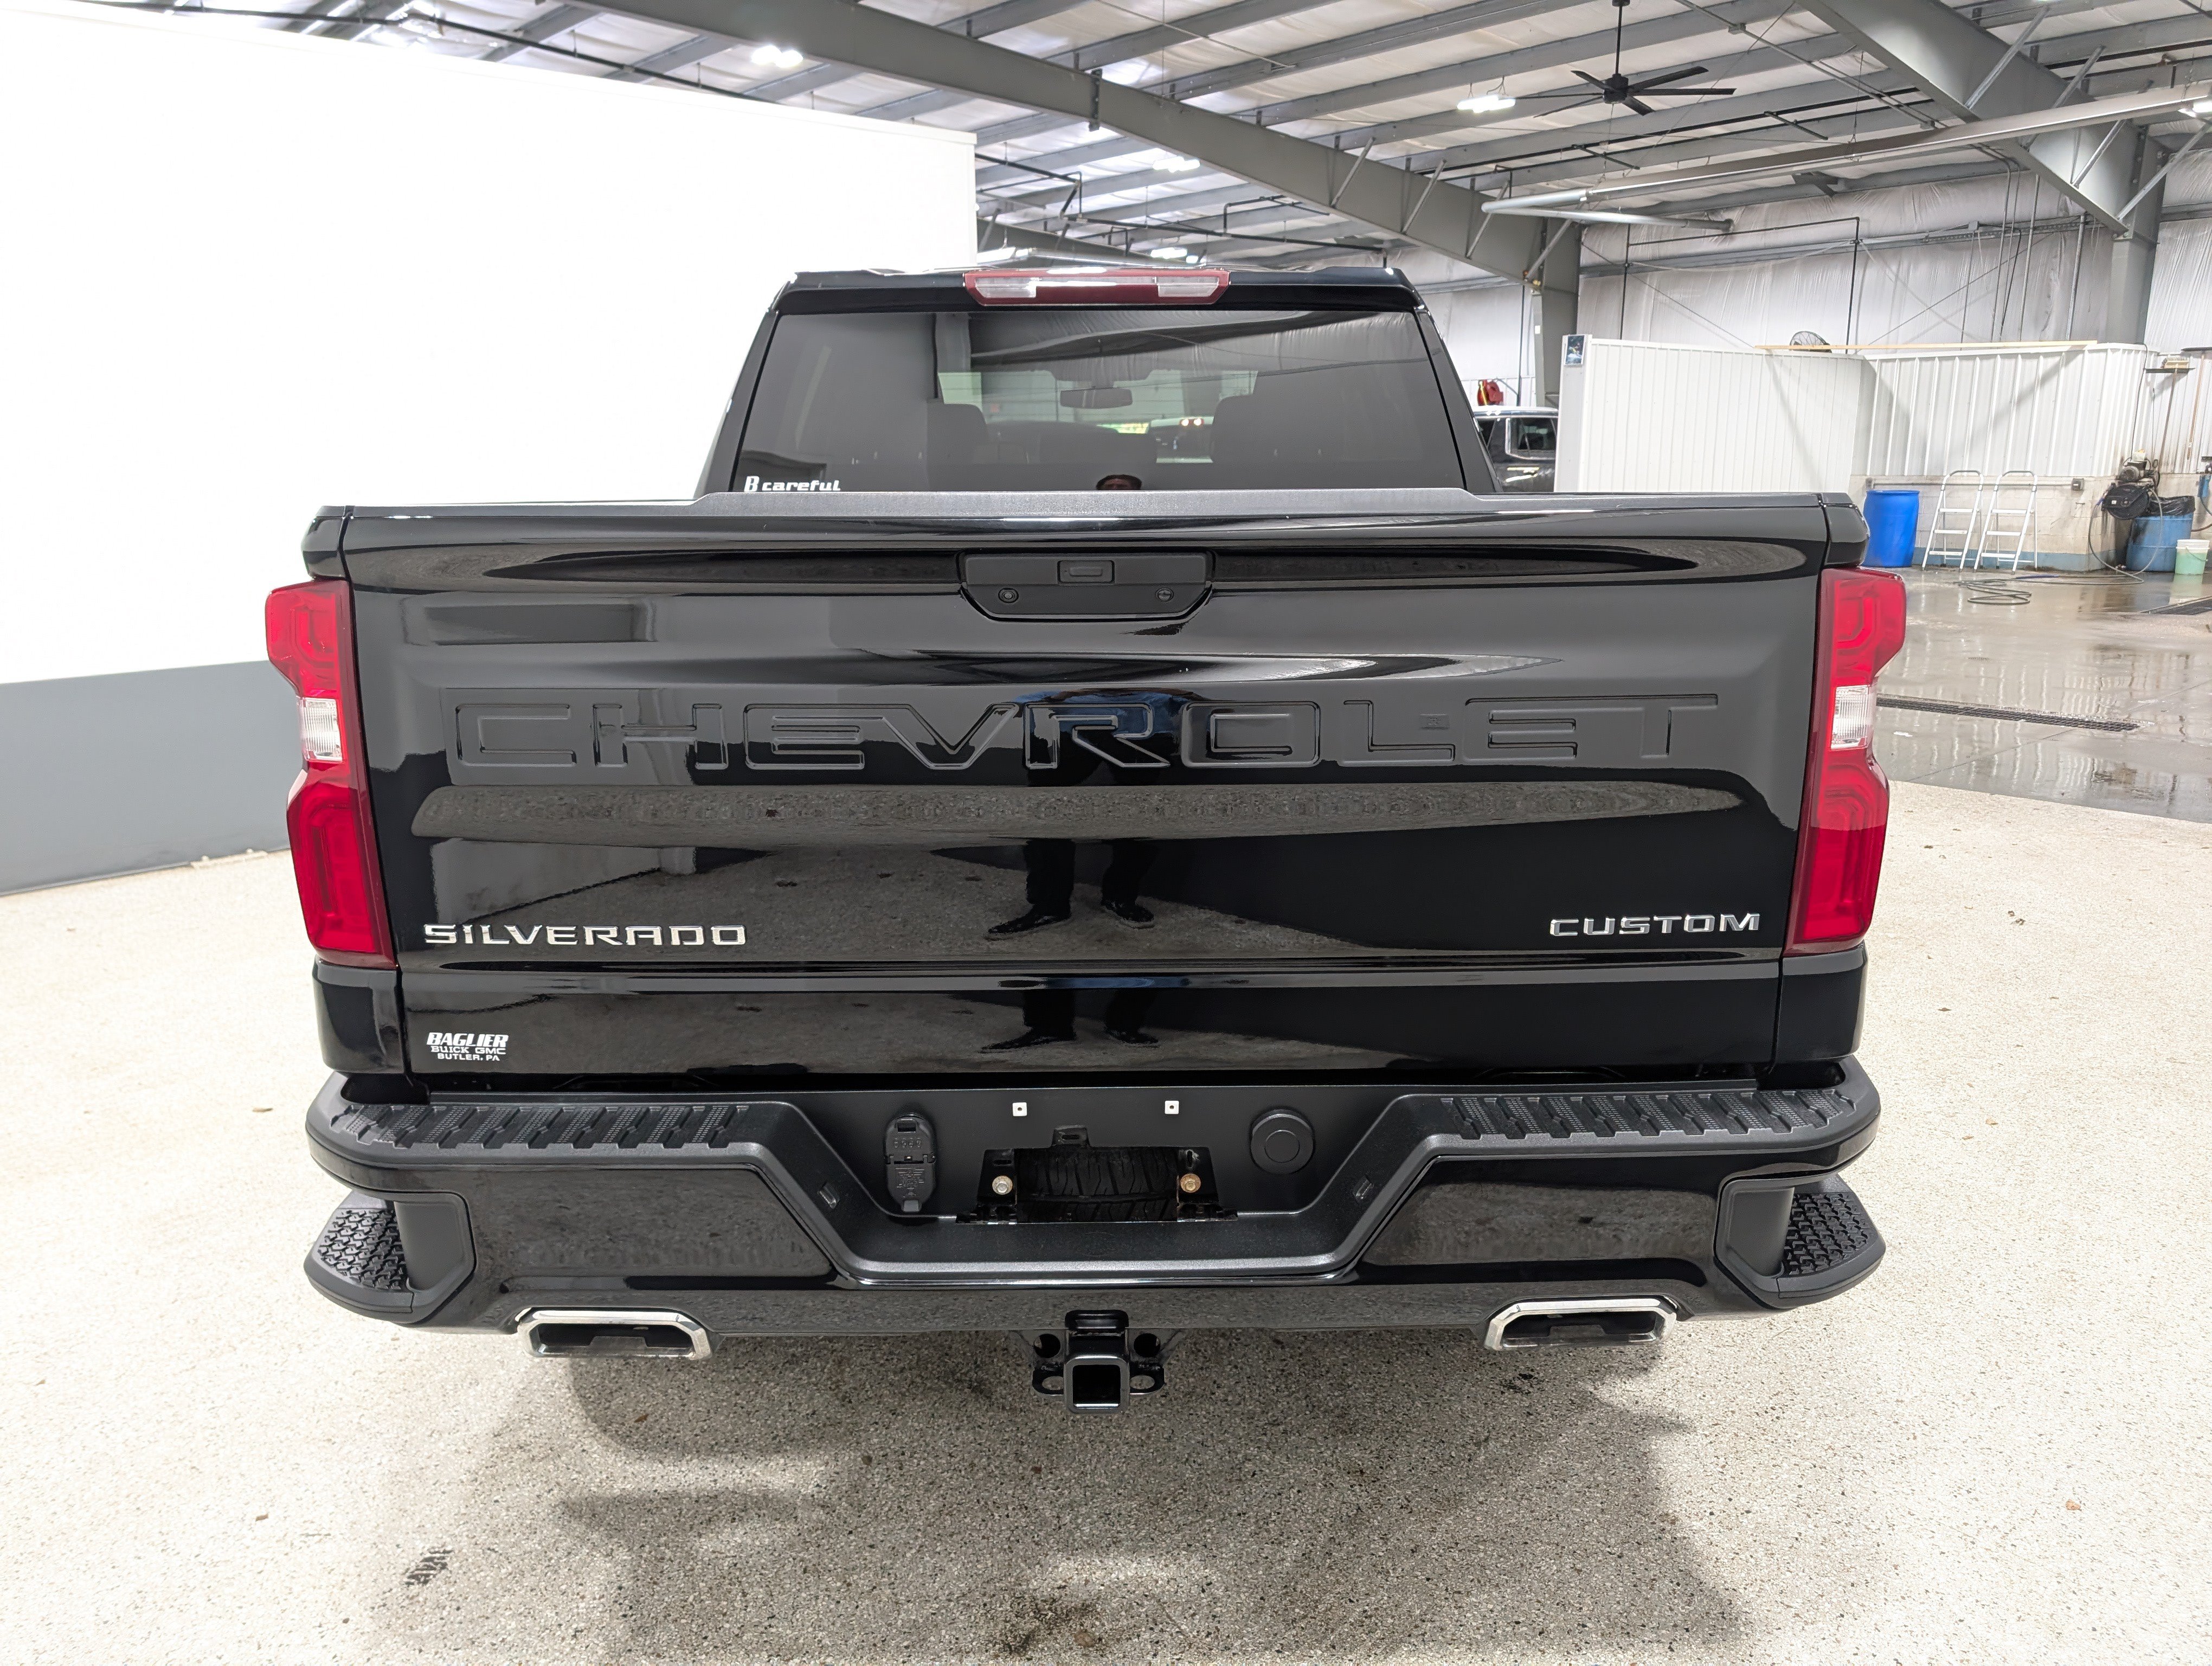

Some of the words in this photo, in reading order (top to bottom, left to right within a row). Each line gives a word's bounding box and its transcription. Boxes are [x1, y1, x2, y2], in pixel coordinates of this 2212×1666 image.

[744, 476, 760, 492] B
[762, 480, 840, 491] careful
[454, 693, 1719, 770] CHEVROLET
[424, 924, 747, 946] SILVERADO
[1549, 913, 1760, 936] CUSTOM
[426, 1032, 509, 1047] BAGLIER
